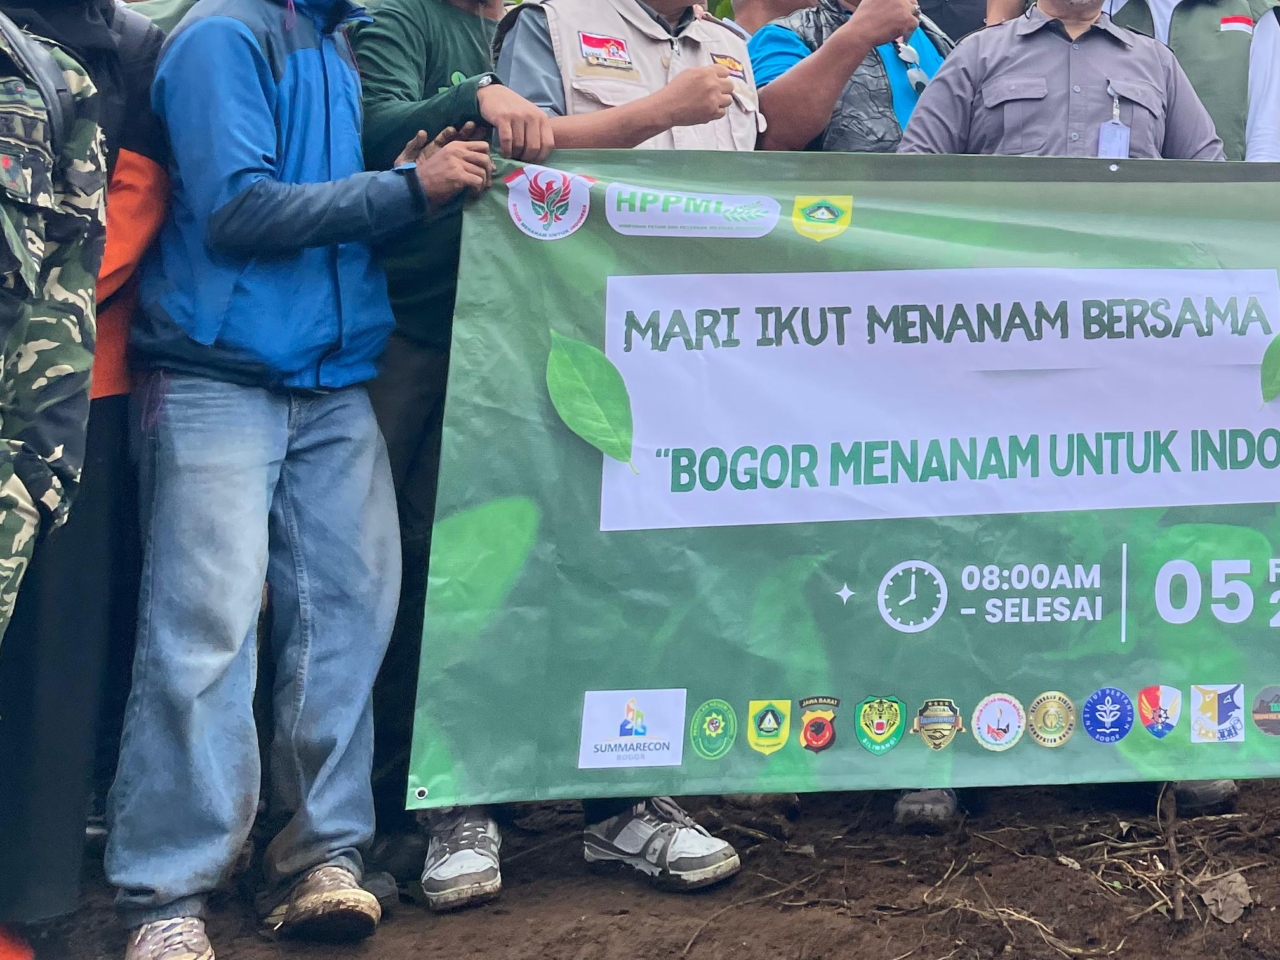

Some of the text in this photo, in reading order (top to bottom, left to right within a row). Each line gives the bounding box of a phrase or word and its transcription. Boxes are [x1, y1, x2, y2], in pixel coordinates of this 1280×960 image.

[616, 190, 723, 214] HPPMI
[623, 296, 1273, 352] MARI IKUT MENANAM BERSAMA
[656, 444, 819, 492] “BOGOR
[829, 434, 1039, 486] MENANAM
[1049, 430, 1181, 477] UNTUK
[961, 563, 1100, 590] 08:00AM
[1155, 559, 1254, 624] 05
[985, 596, 1102, 623] SELESAI
[802, 697, 838, 707] JAWA BARAT
[1084, 689, 1132, 730] INSTITUT PERTANIAN
[593, 742, 670, 753] SUMMARECON
[862, 737, 897, 751] SILIWANGI
[1095, 733, 1120, 742] BOGOR
